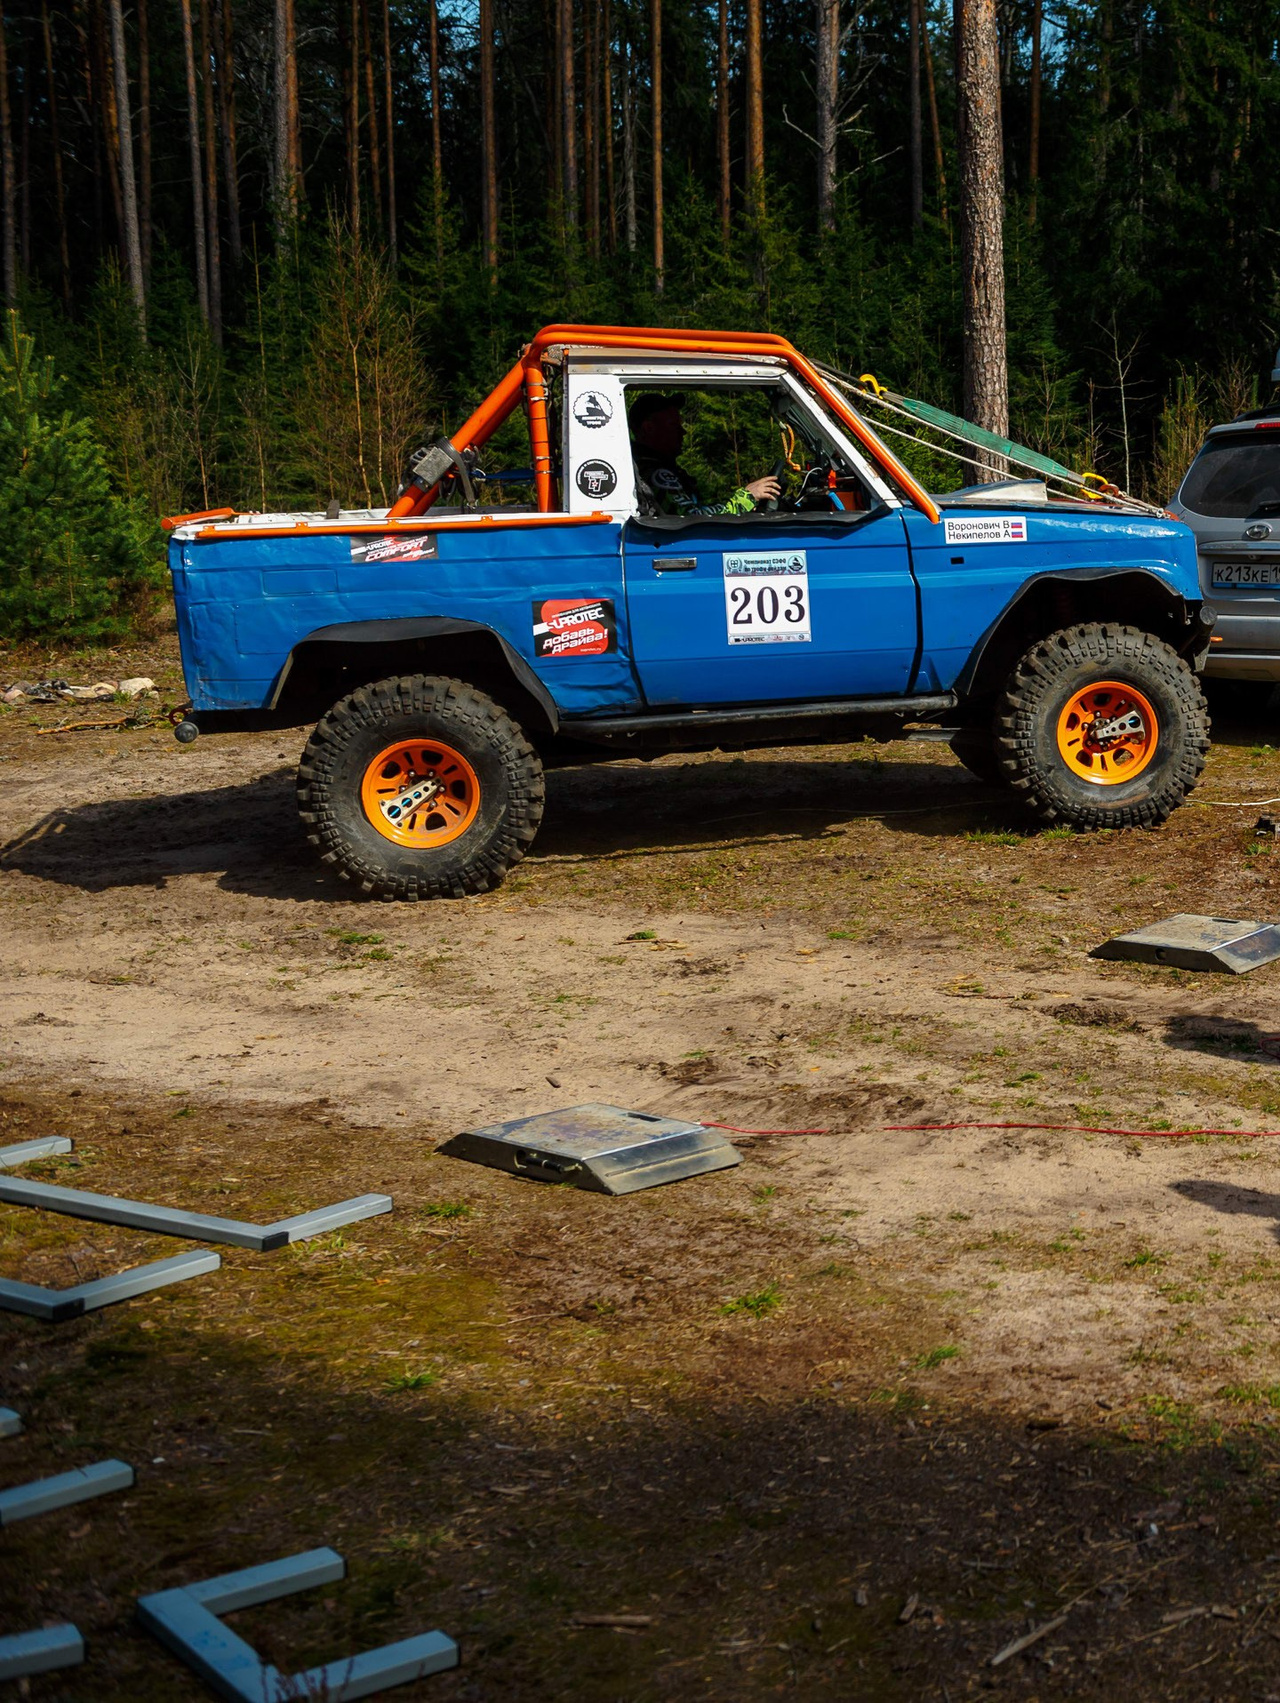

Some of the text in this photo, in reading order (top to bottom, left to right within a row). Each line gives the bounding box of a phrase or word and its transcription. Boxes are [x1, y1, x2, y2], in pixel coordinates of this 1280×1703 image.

[948, 520, 1010, 532] Воронович В
[948, 529, 1011, 540] Некипелов А
[1215, 566, 1269, 583] К213КЕ
[730, 585, 805, 625] 203
[546, 607, 605, 629] SUPROTEC
[543, 627, 595, 650] добавь
[551, 628, 609, 655] драйва!
